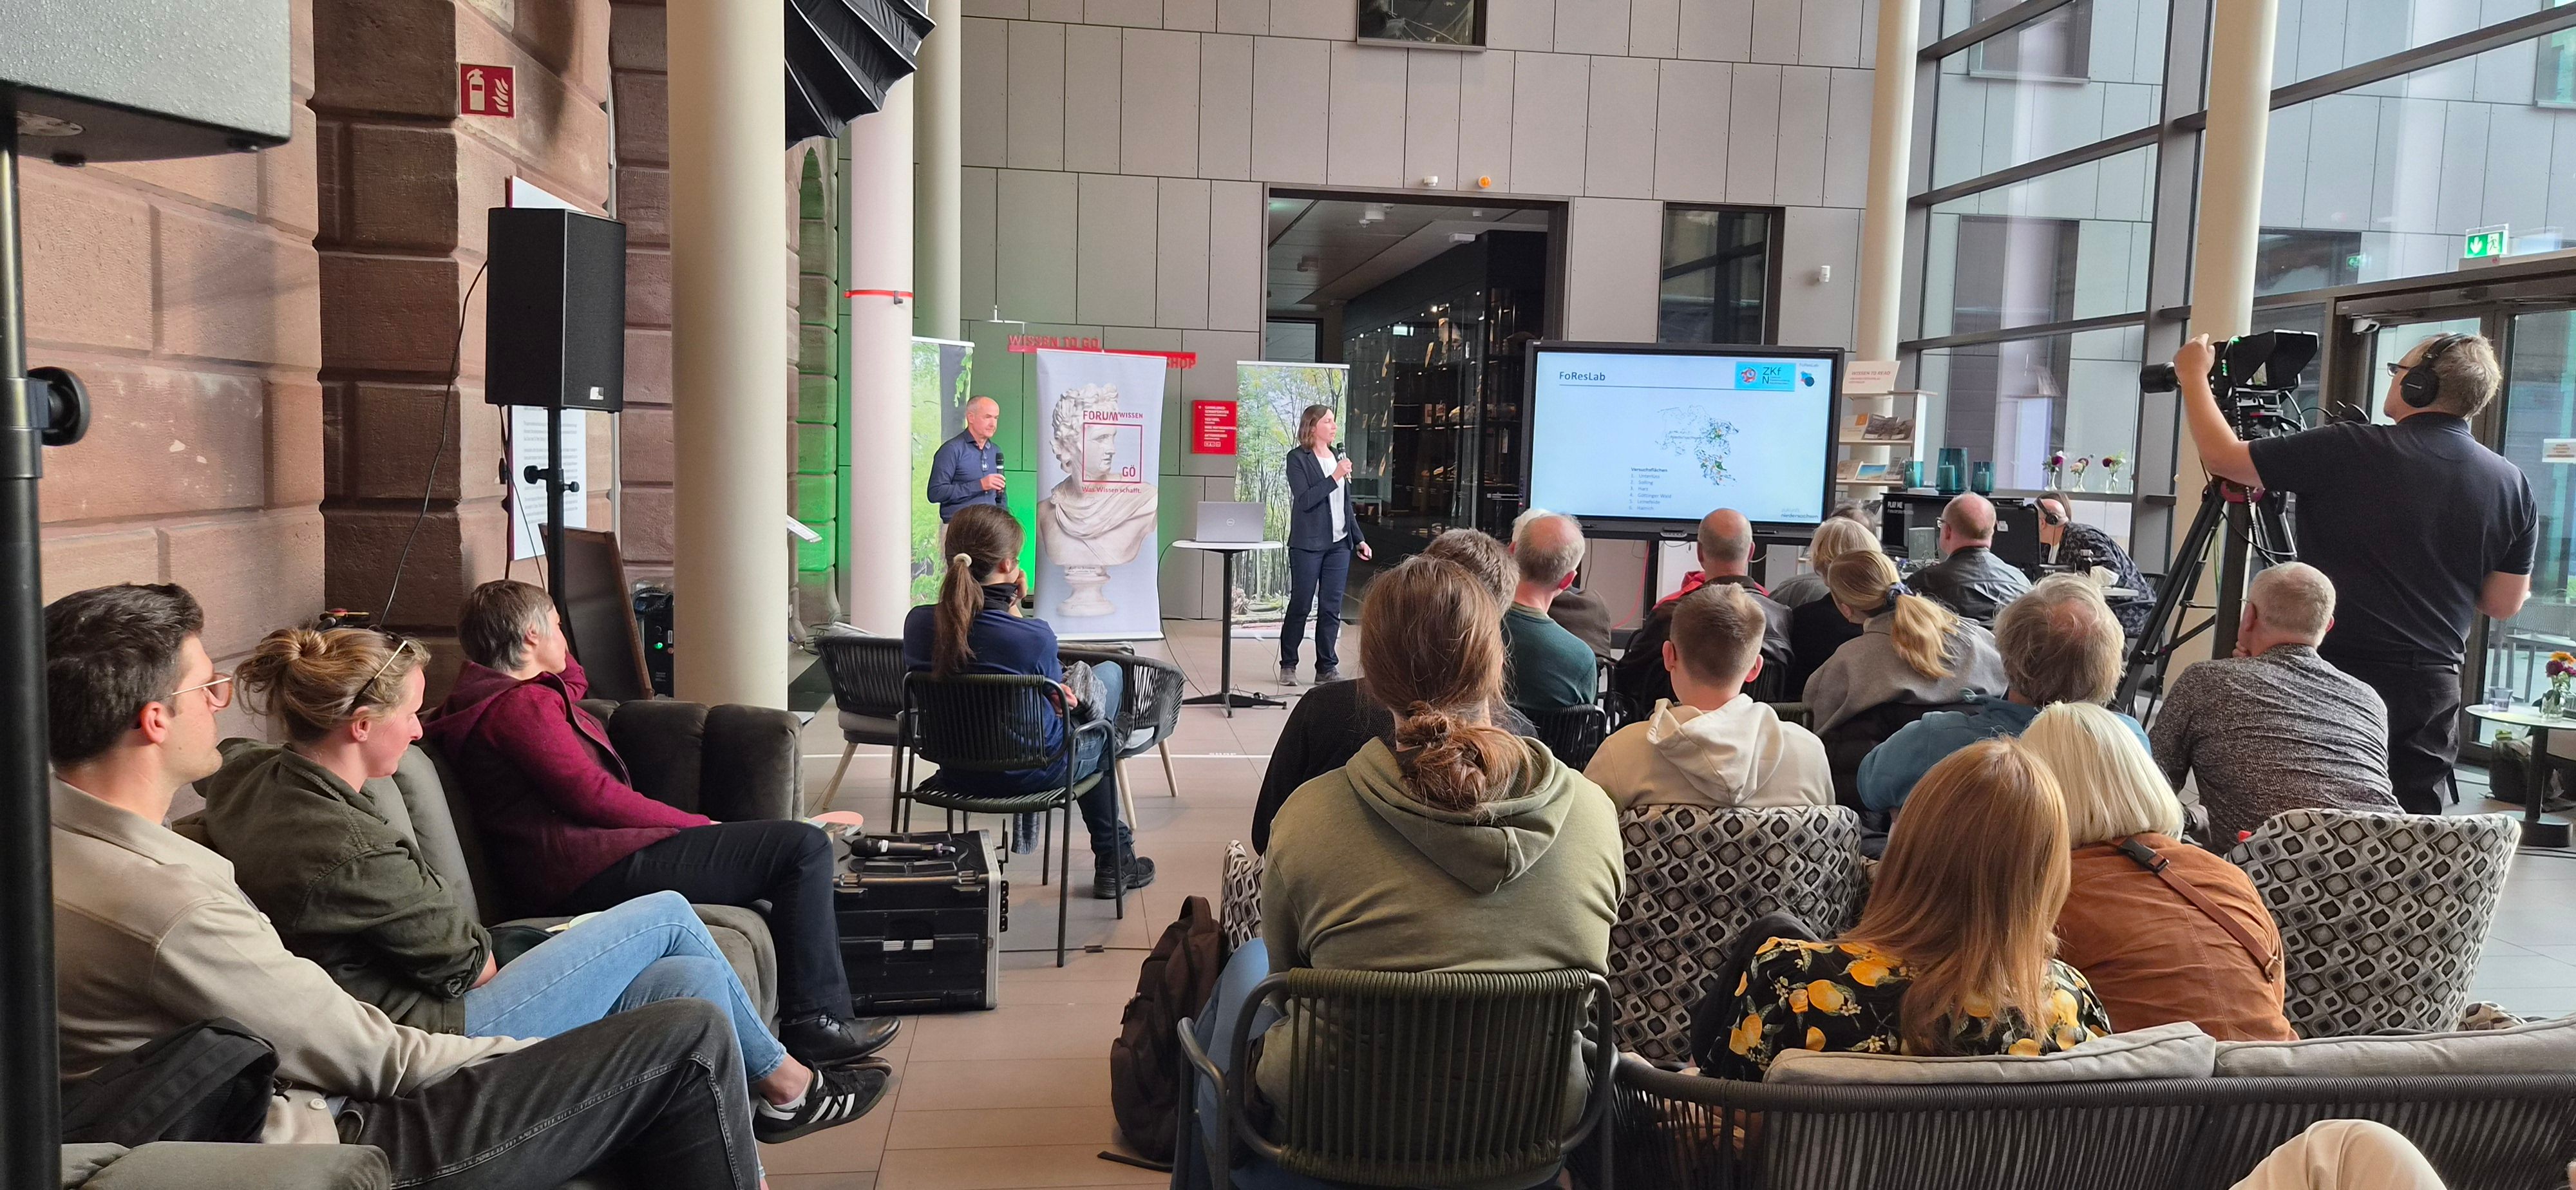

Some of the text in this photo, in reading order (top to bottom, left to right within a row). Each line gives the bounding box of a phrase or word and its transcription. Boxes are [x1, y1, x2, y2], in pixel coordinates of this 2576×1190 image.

[1009, 334, 1101, 349] WISSEN TO GO
[1559, 371, 1605, 381] FoResLab
[1762, 366, 1782, 376] ZKf
[1083, 410, 1118, 421] FORUM
[1122, 464, 1136, 477] GÖ
